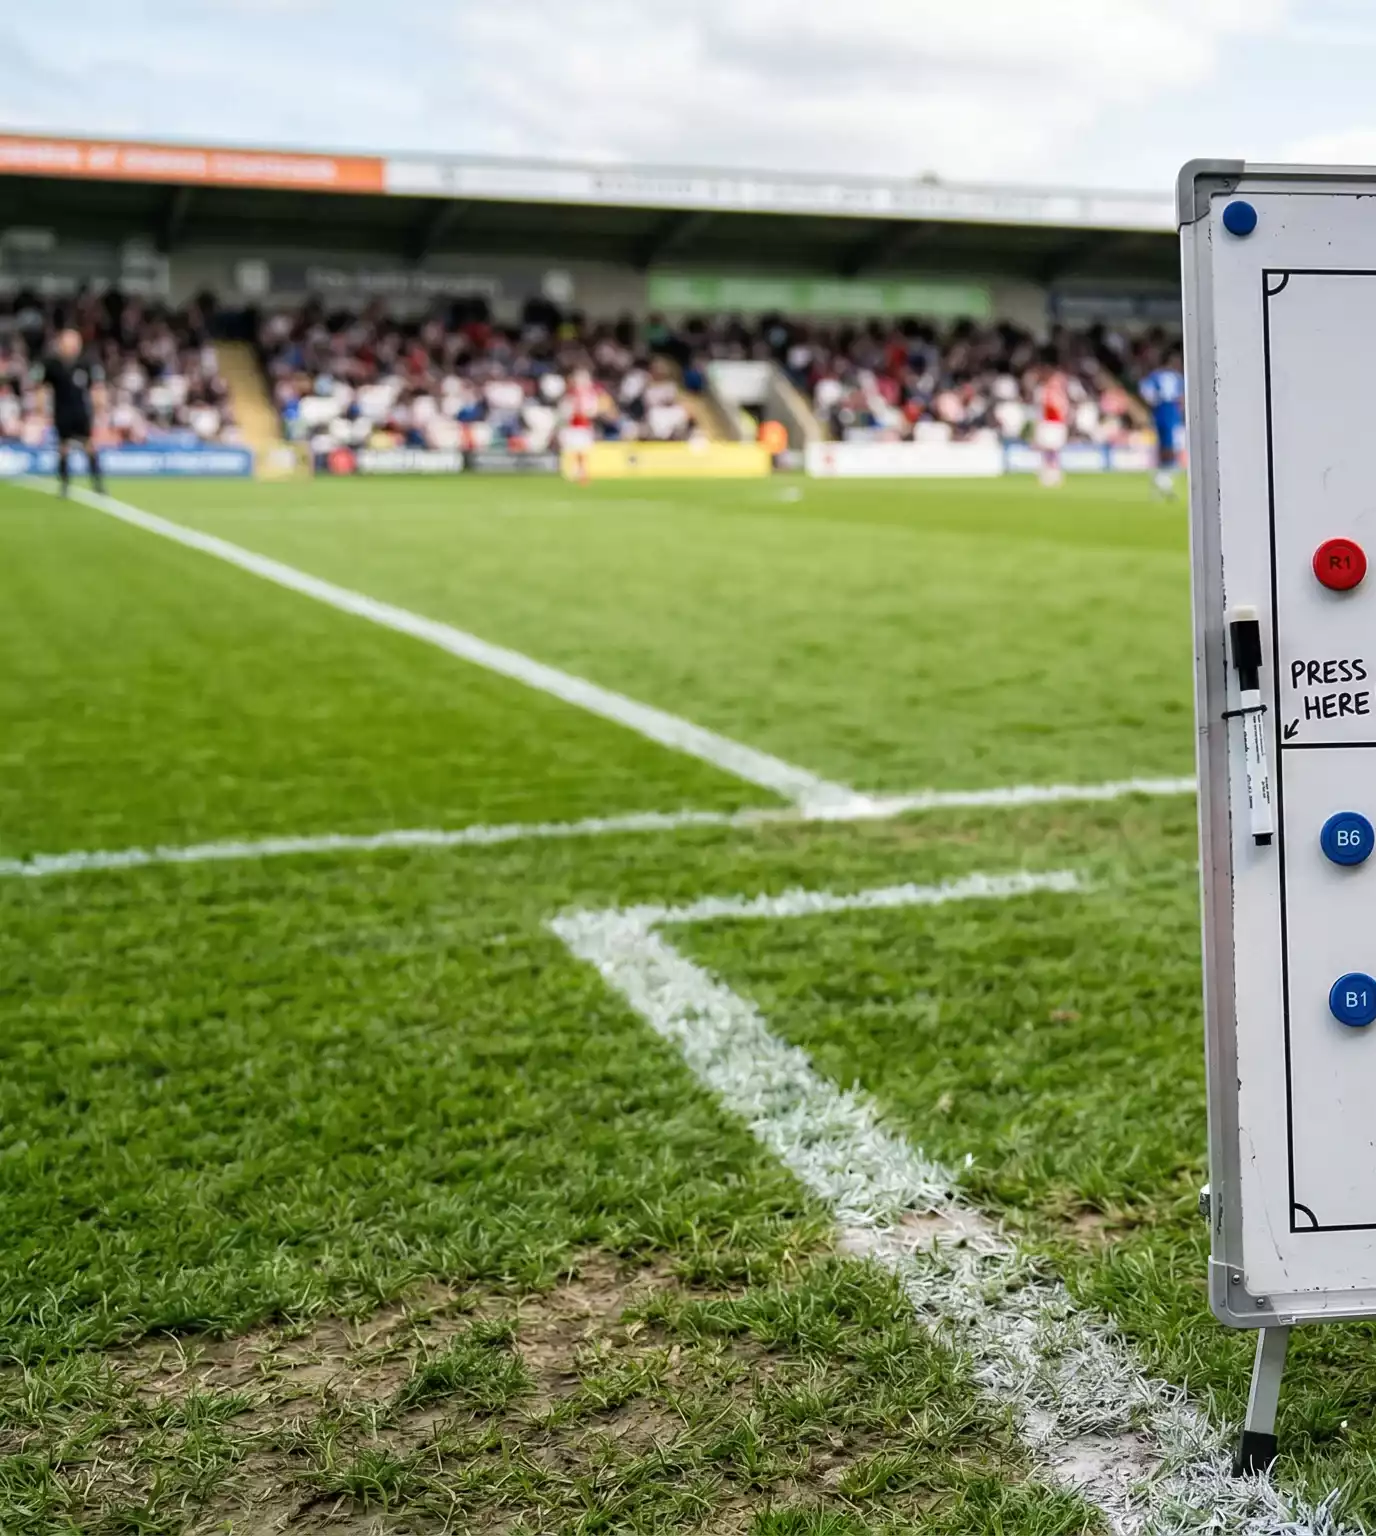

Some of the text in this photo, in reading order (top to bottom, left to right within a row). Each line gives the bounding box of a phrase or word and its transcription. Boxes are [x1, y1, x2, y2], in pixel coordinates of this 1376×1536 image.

[1329, 555, 1351, 570] R1
[1291, 659, 1367, 689] PRESS
[1337, 830, 1360, 846] B6
[1346, 992, 1367, 1007] B1
